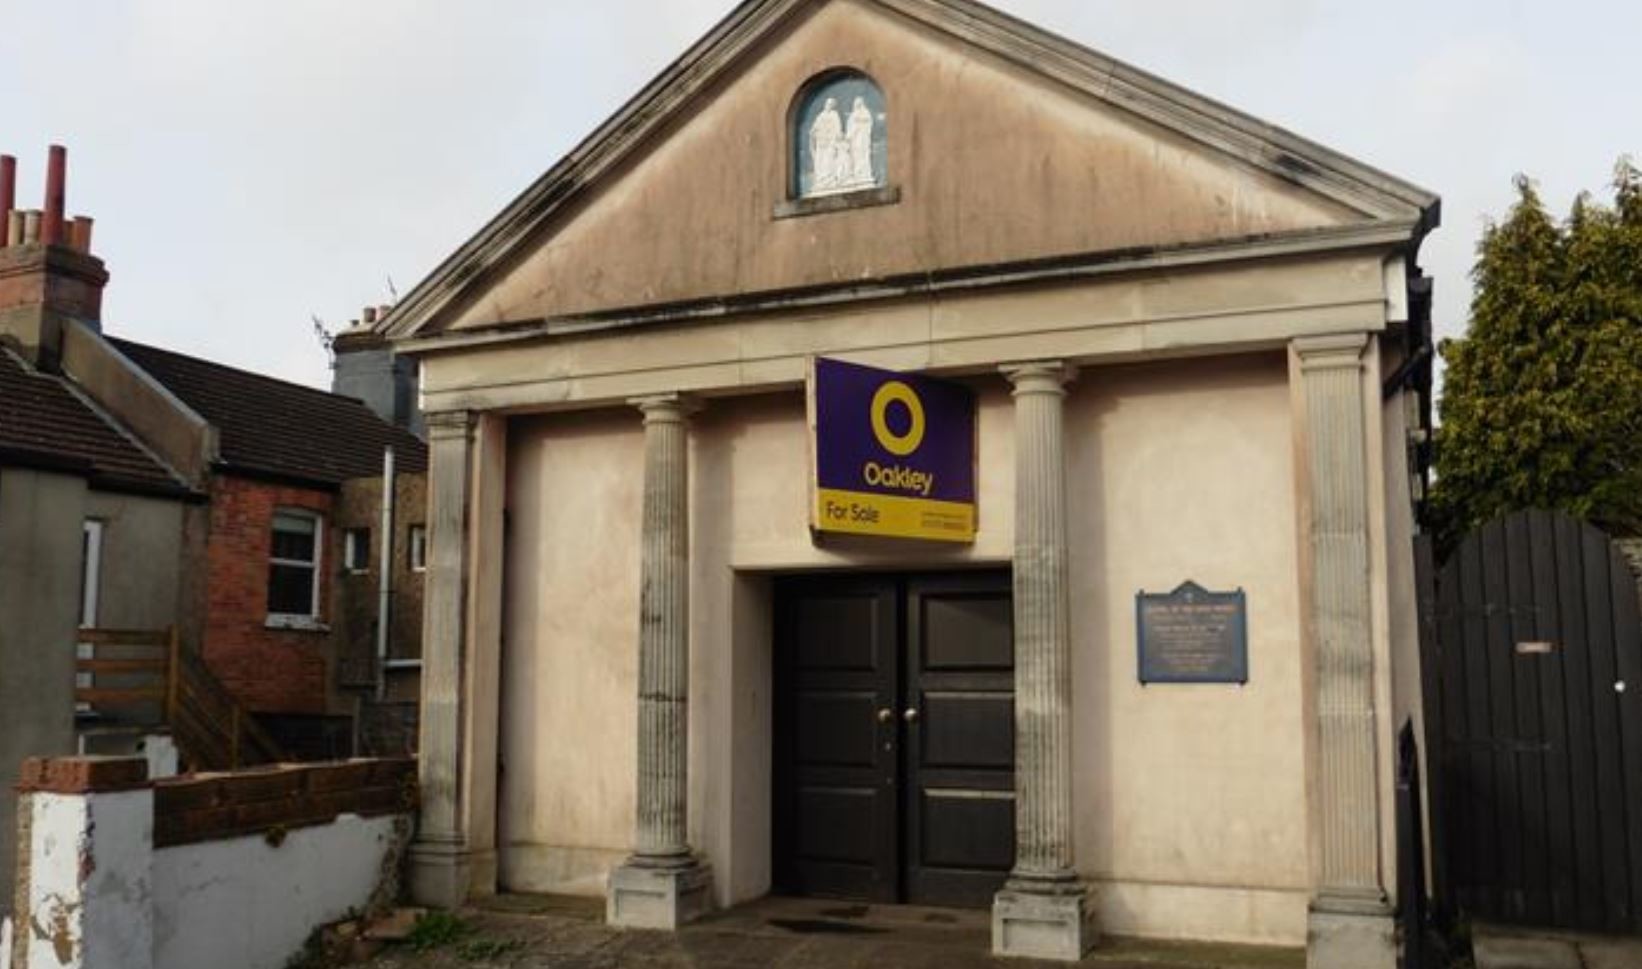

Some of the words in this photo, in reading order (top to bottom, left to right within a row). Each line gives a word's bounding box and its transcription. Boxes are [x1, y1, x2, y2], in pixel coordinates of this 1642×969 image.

[864, 462, 933, 496] Oakley
[827, 502, 847, 521] For
[852, 504, 880, 523] Sale
